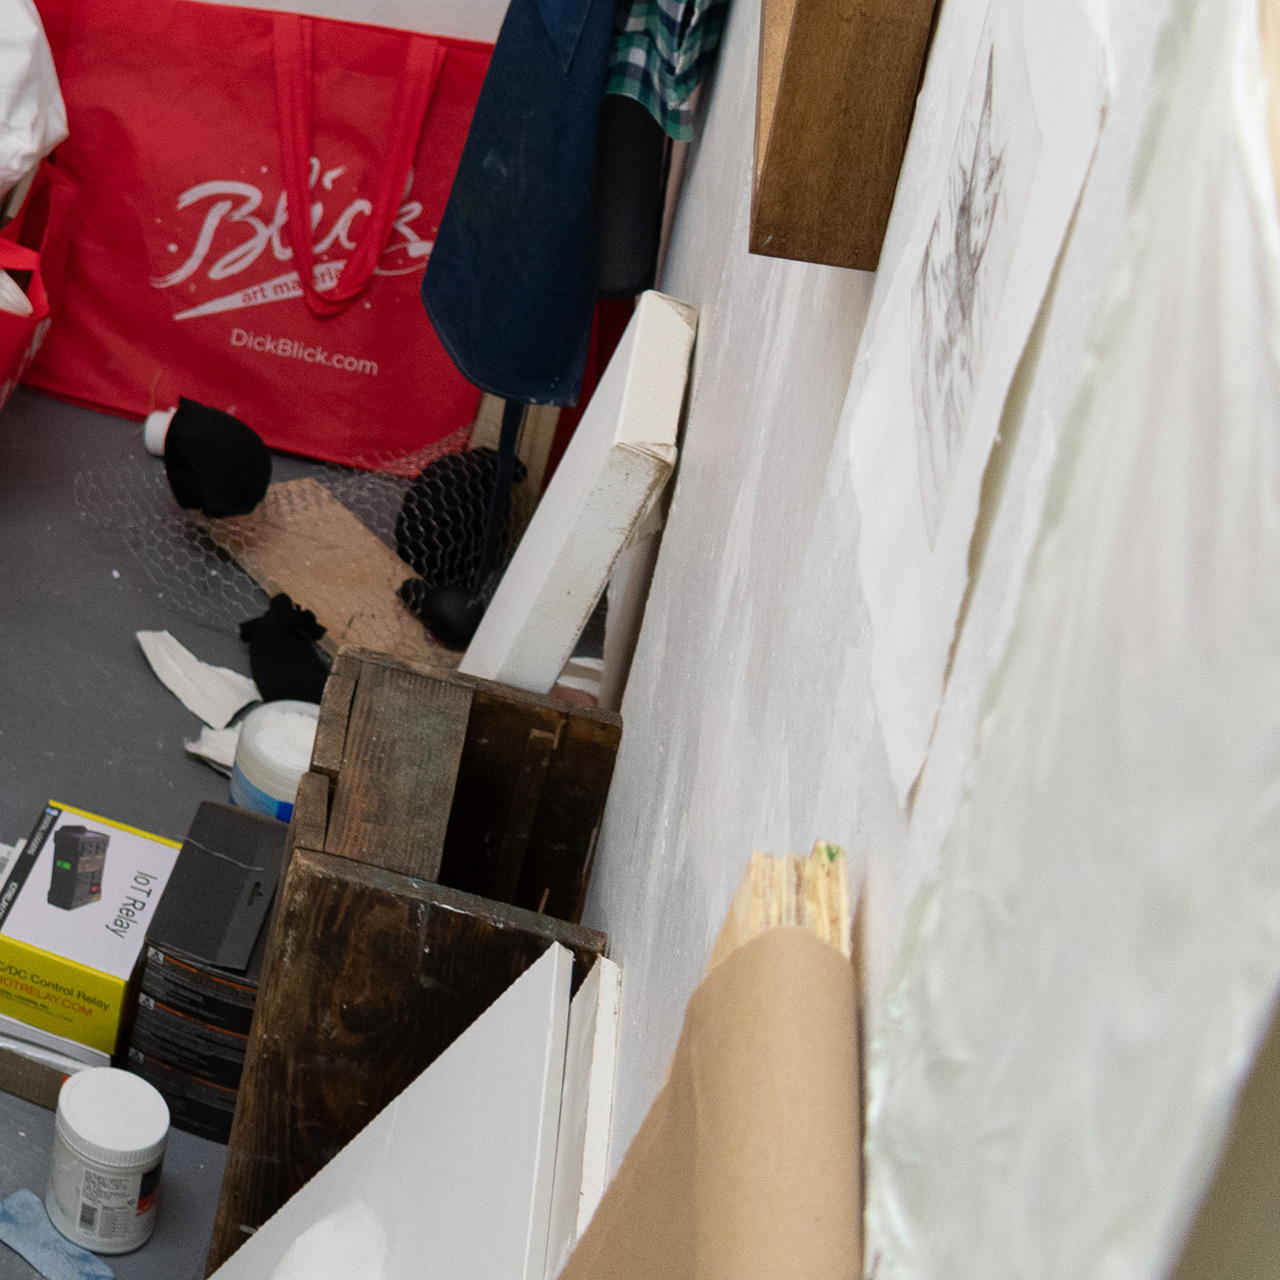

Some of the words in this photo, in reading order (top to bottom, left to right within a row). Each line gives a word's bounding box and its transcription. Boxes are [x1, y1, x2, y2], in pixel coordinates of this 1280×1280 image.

[241, 284, 269, 304] art
[230, 326, 379, 376] DickBlick.com
[131, 870, 158, 898] IoT
[105, 896, 146, 939] Relay
[30, 973, 74, 997] Control
[77, 989, 111, 1013] Relay
